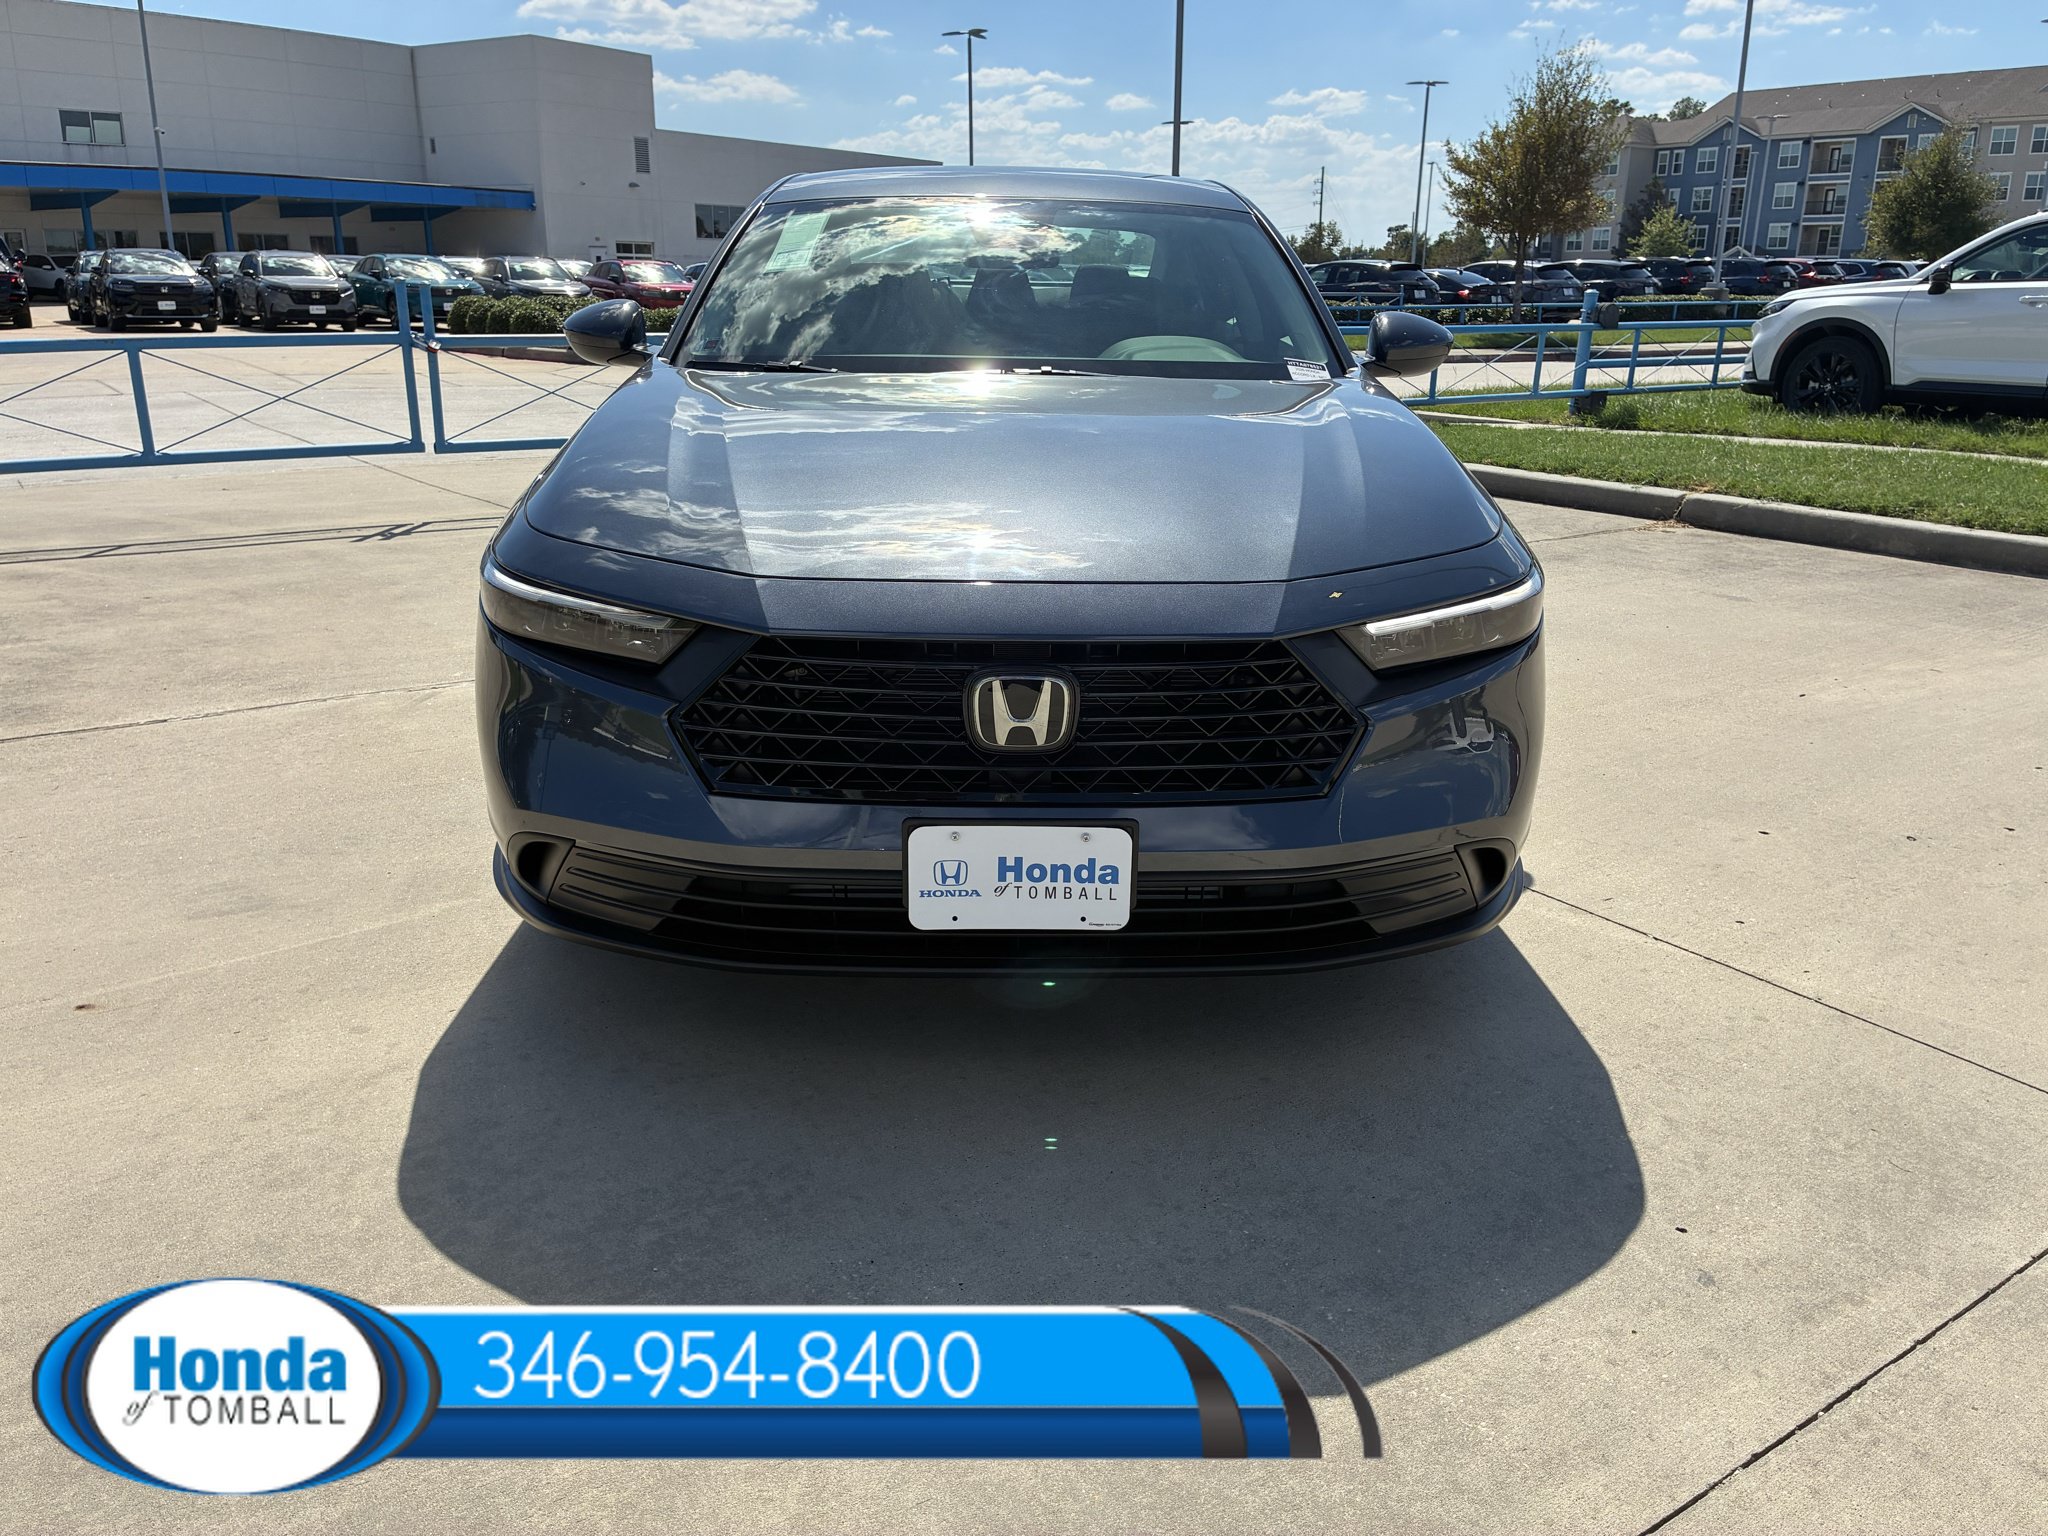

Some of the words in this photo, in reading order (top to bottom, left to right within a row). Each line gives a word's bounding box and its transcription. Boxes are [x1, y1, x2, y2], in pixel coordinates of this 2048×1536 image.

[997, 856, 1119, 885] Honda
[919, 889, 982, 898] HONDA
[994, 882, 1013, 897] of
[1014, 885, 1117, 901] TOMBALL
